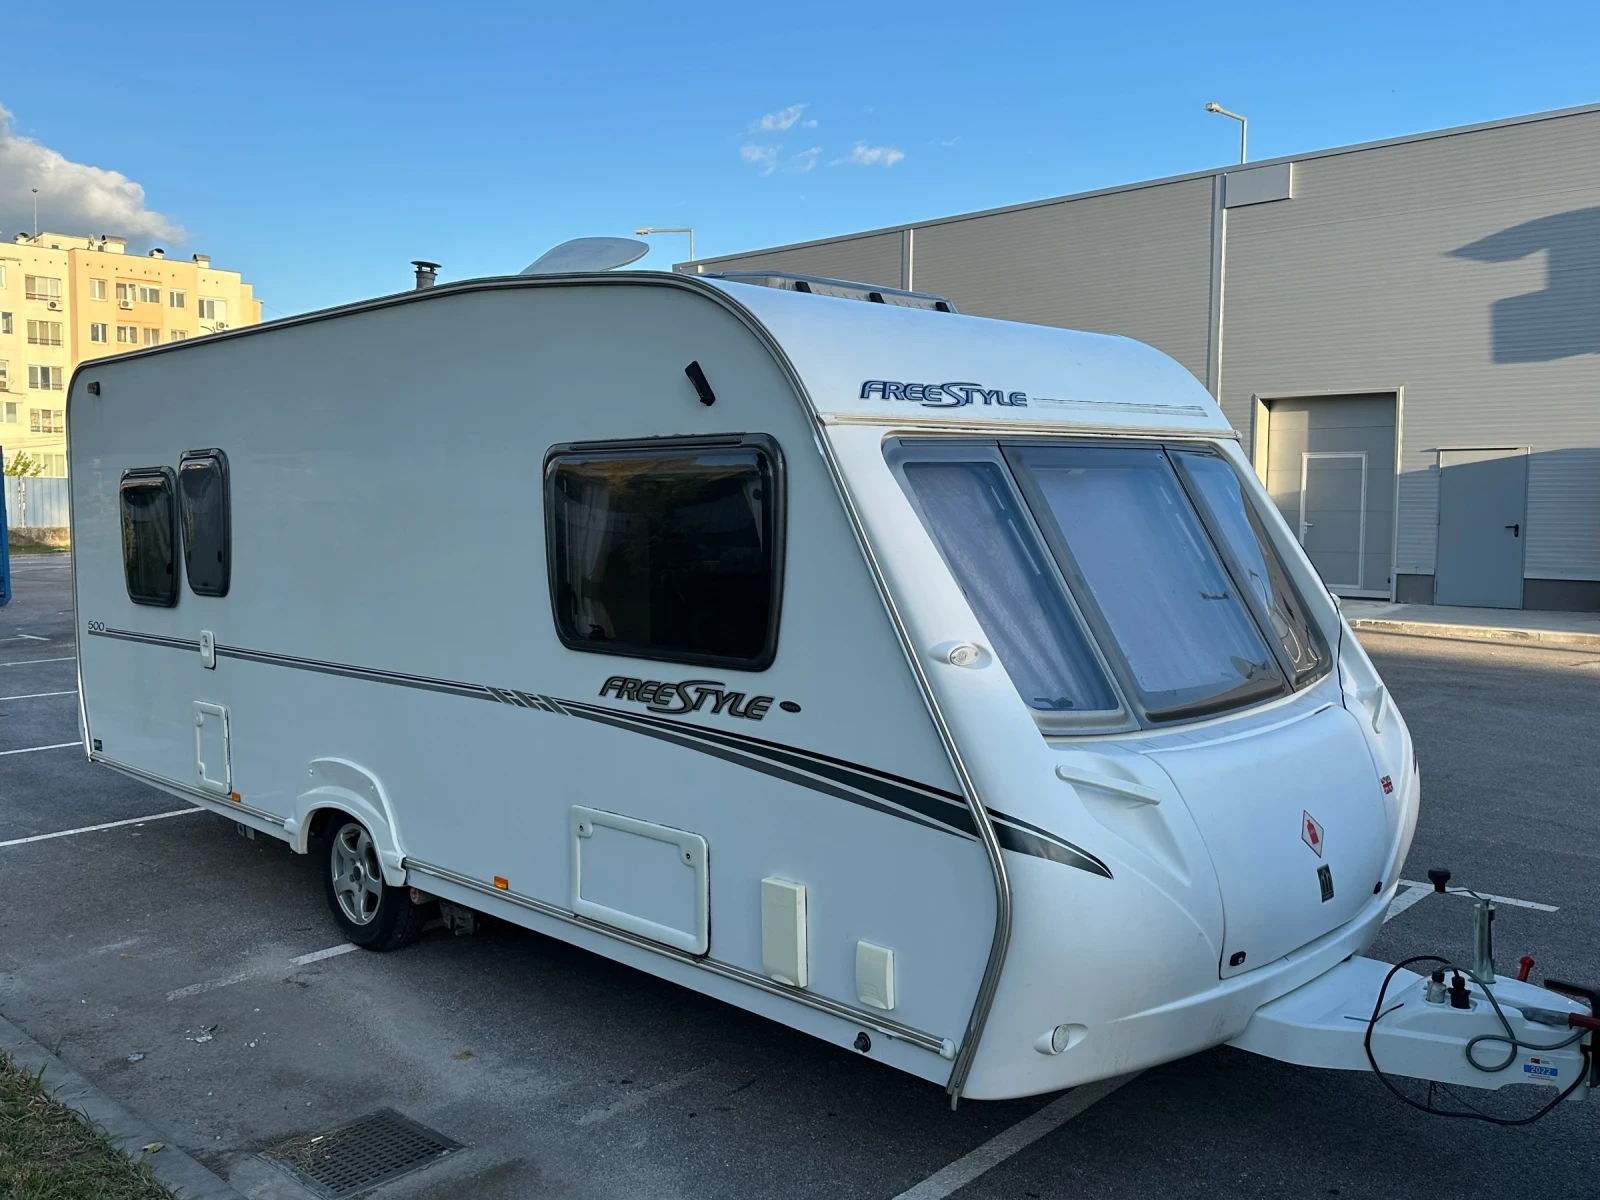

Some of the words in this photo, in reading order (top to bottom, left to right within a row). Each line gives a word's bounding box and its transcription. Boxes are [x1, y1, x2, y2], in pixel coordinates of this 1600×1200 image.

[860, 380, 1028, 407] FREESTYLE
[88, 620, 105, 632] 500
[598, 676, 776, 721] FREESTYLE
[1530, 1066, 1552, 1075] 2022
